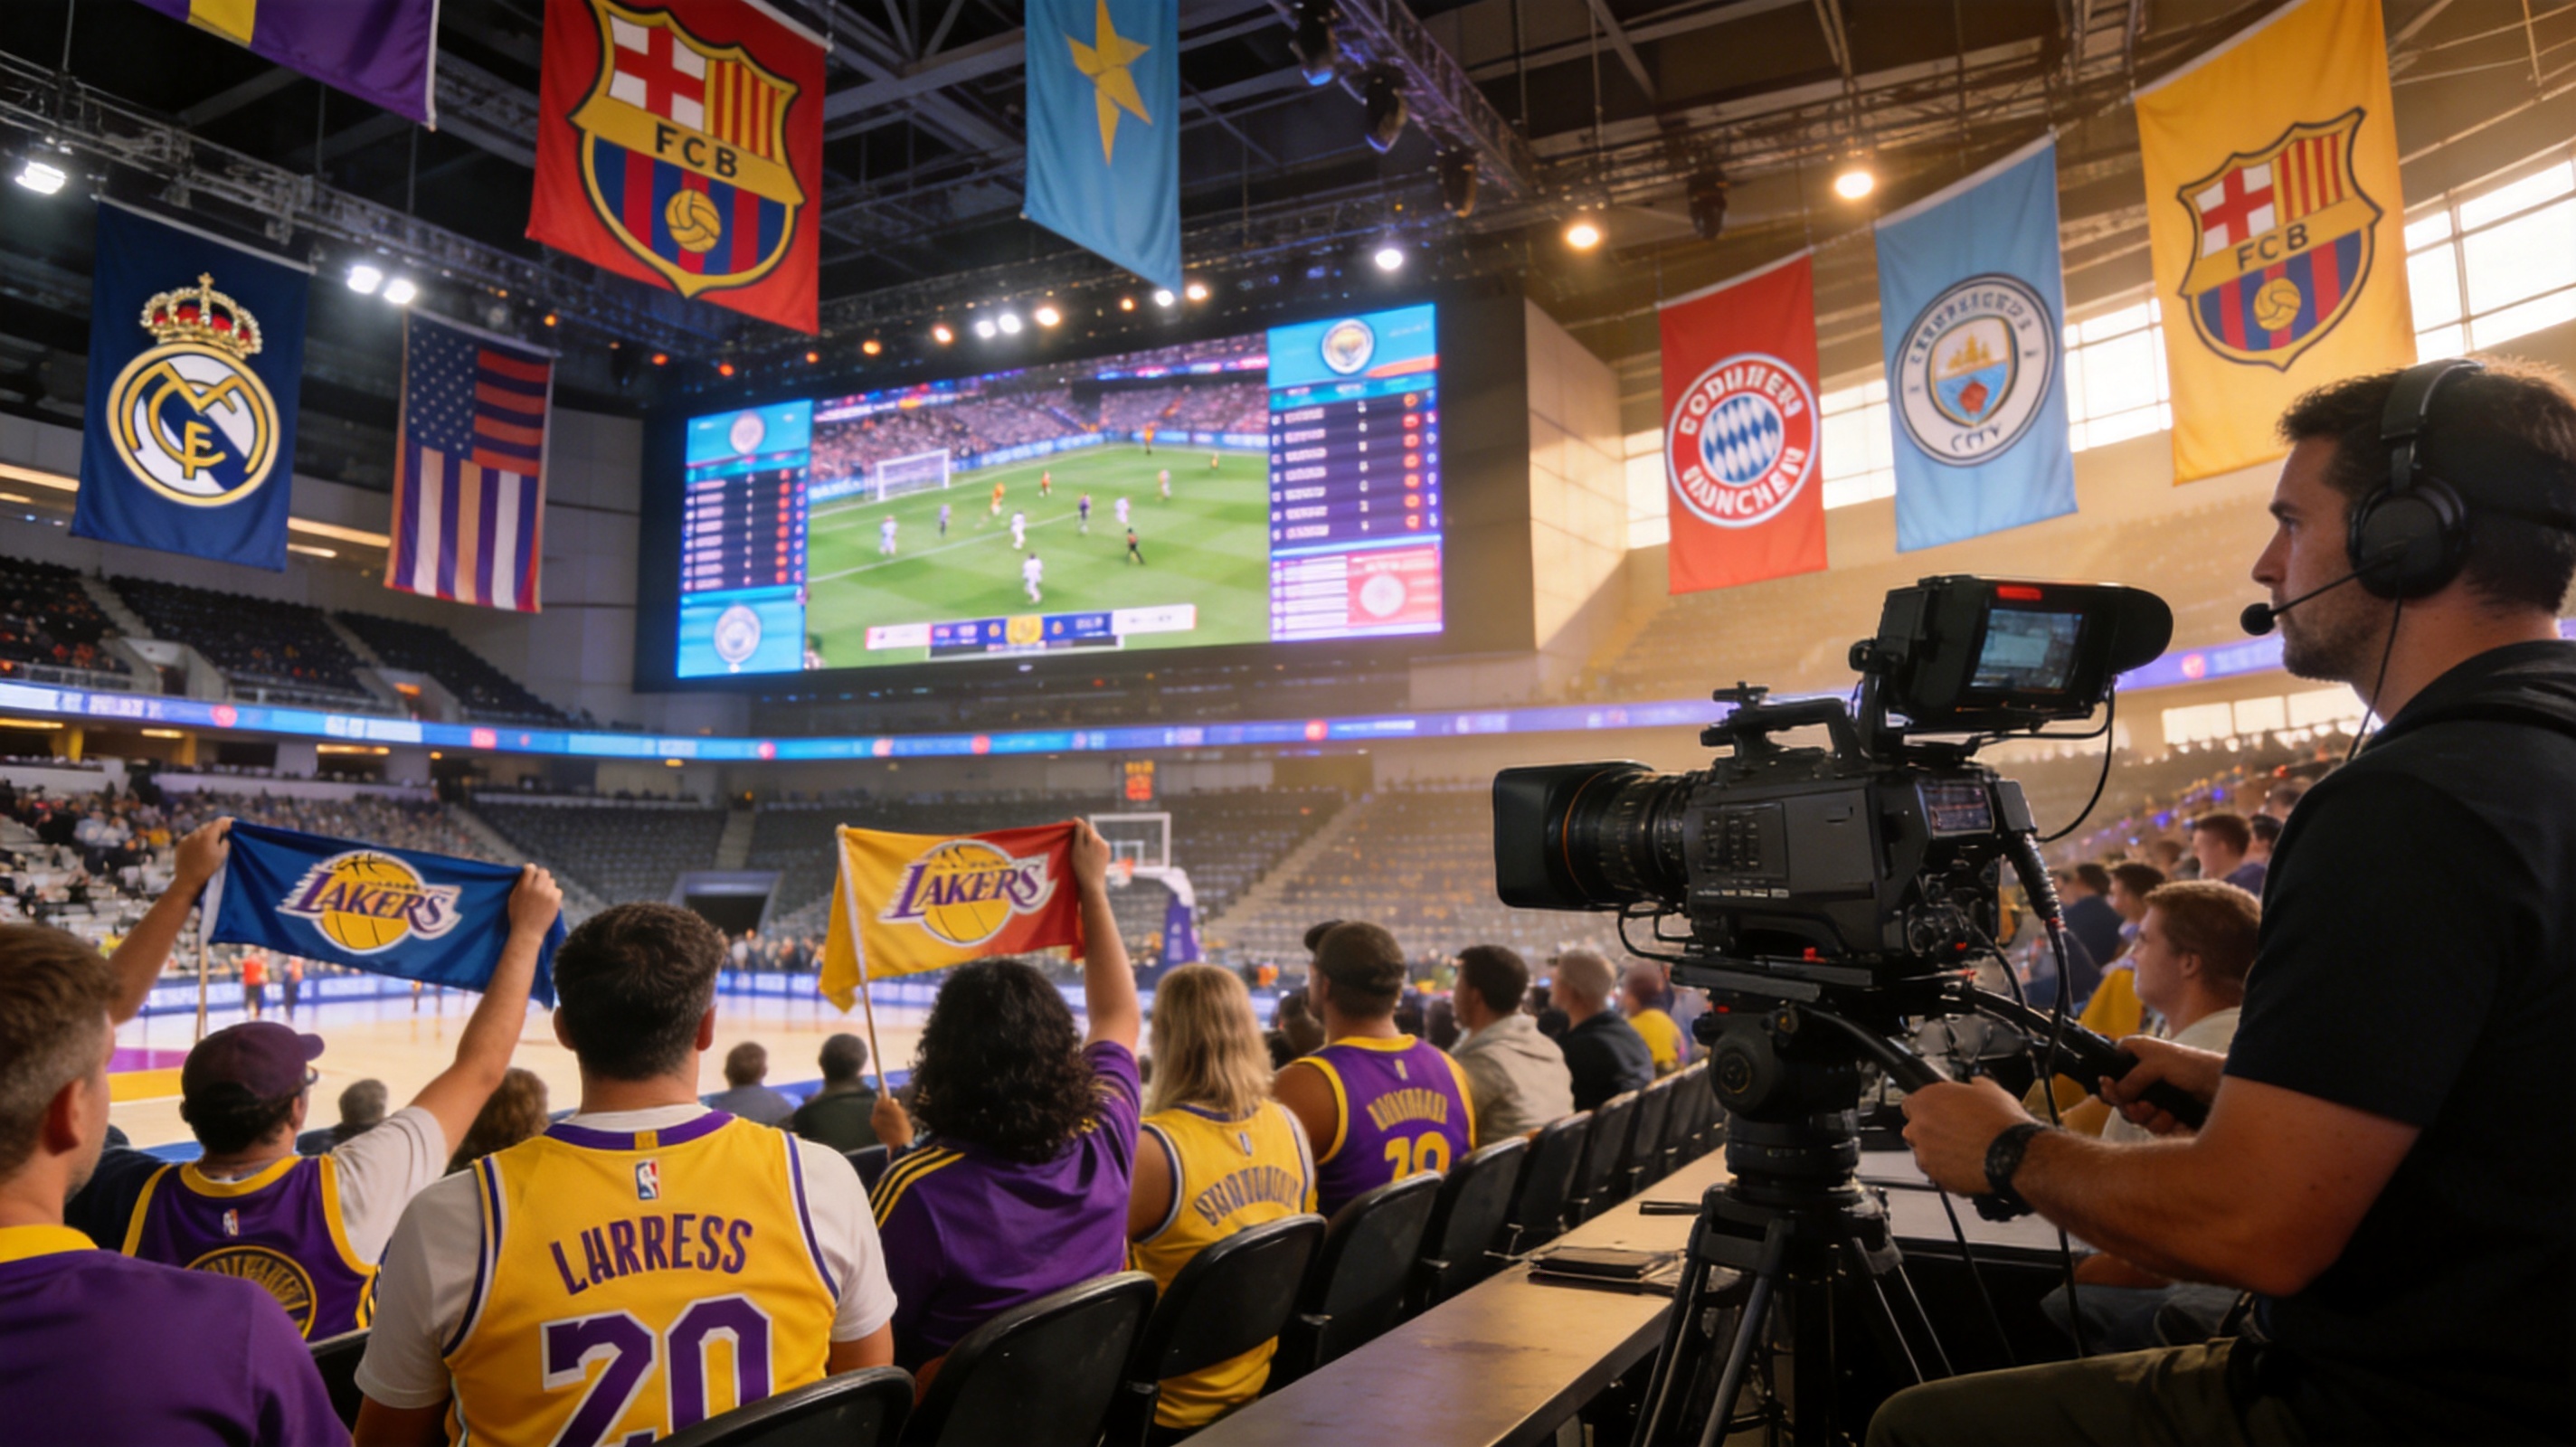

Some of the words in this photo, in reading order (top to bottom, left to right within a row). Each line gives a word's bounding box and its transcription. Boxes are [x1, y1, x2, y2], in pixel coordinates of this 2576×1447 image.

[656, 121, 737, 178] FCB
[2237, 222, 2308, 272] FCB
[289, 871, 448, 933] LAKERS
[878, 863, 1040, 920] LAKERS
[541, 1293, 773, 1447] 20
